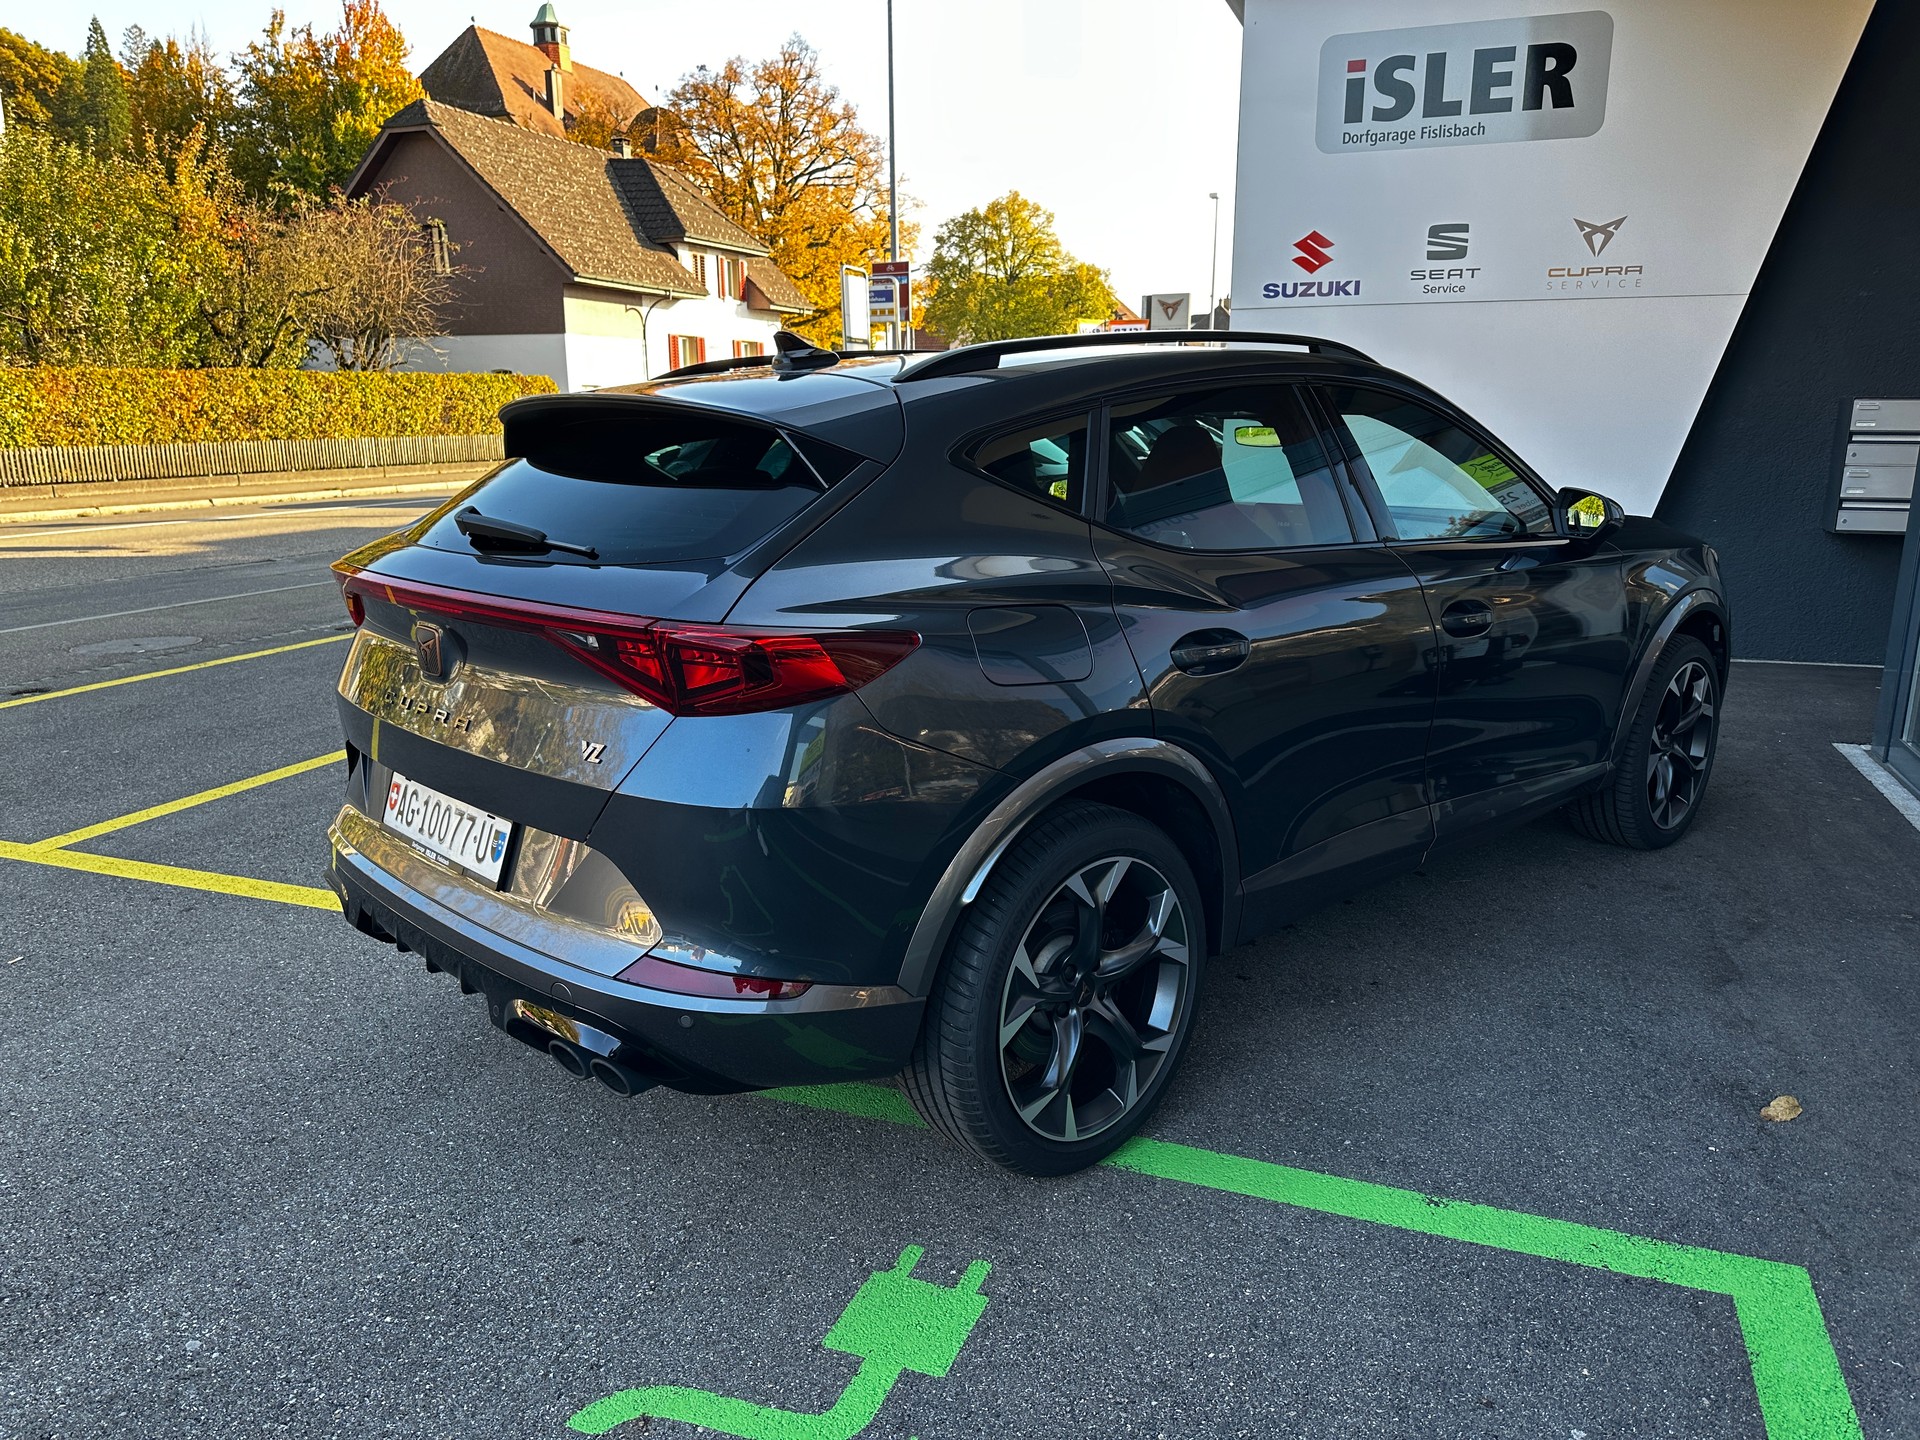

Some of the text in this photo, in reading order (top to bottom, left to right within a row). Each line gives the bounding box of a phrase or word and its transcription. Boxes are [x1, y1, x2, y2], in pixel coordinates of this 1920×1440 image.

[1342, 122, 1486, 146] Dorfgarage Fislisbach
[1410, 268, 1481, 281] SEAT
[1547, 265, 1643, 278] CUPRA
[1262, 280, 1361, 299] SUZUKI
[1422, 282, 1466, 294] Service
[1546, 279, 1642, 290] SERVICE
[384, 690, 472, 734] CUPRA
